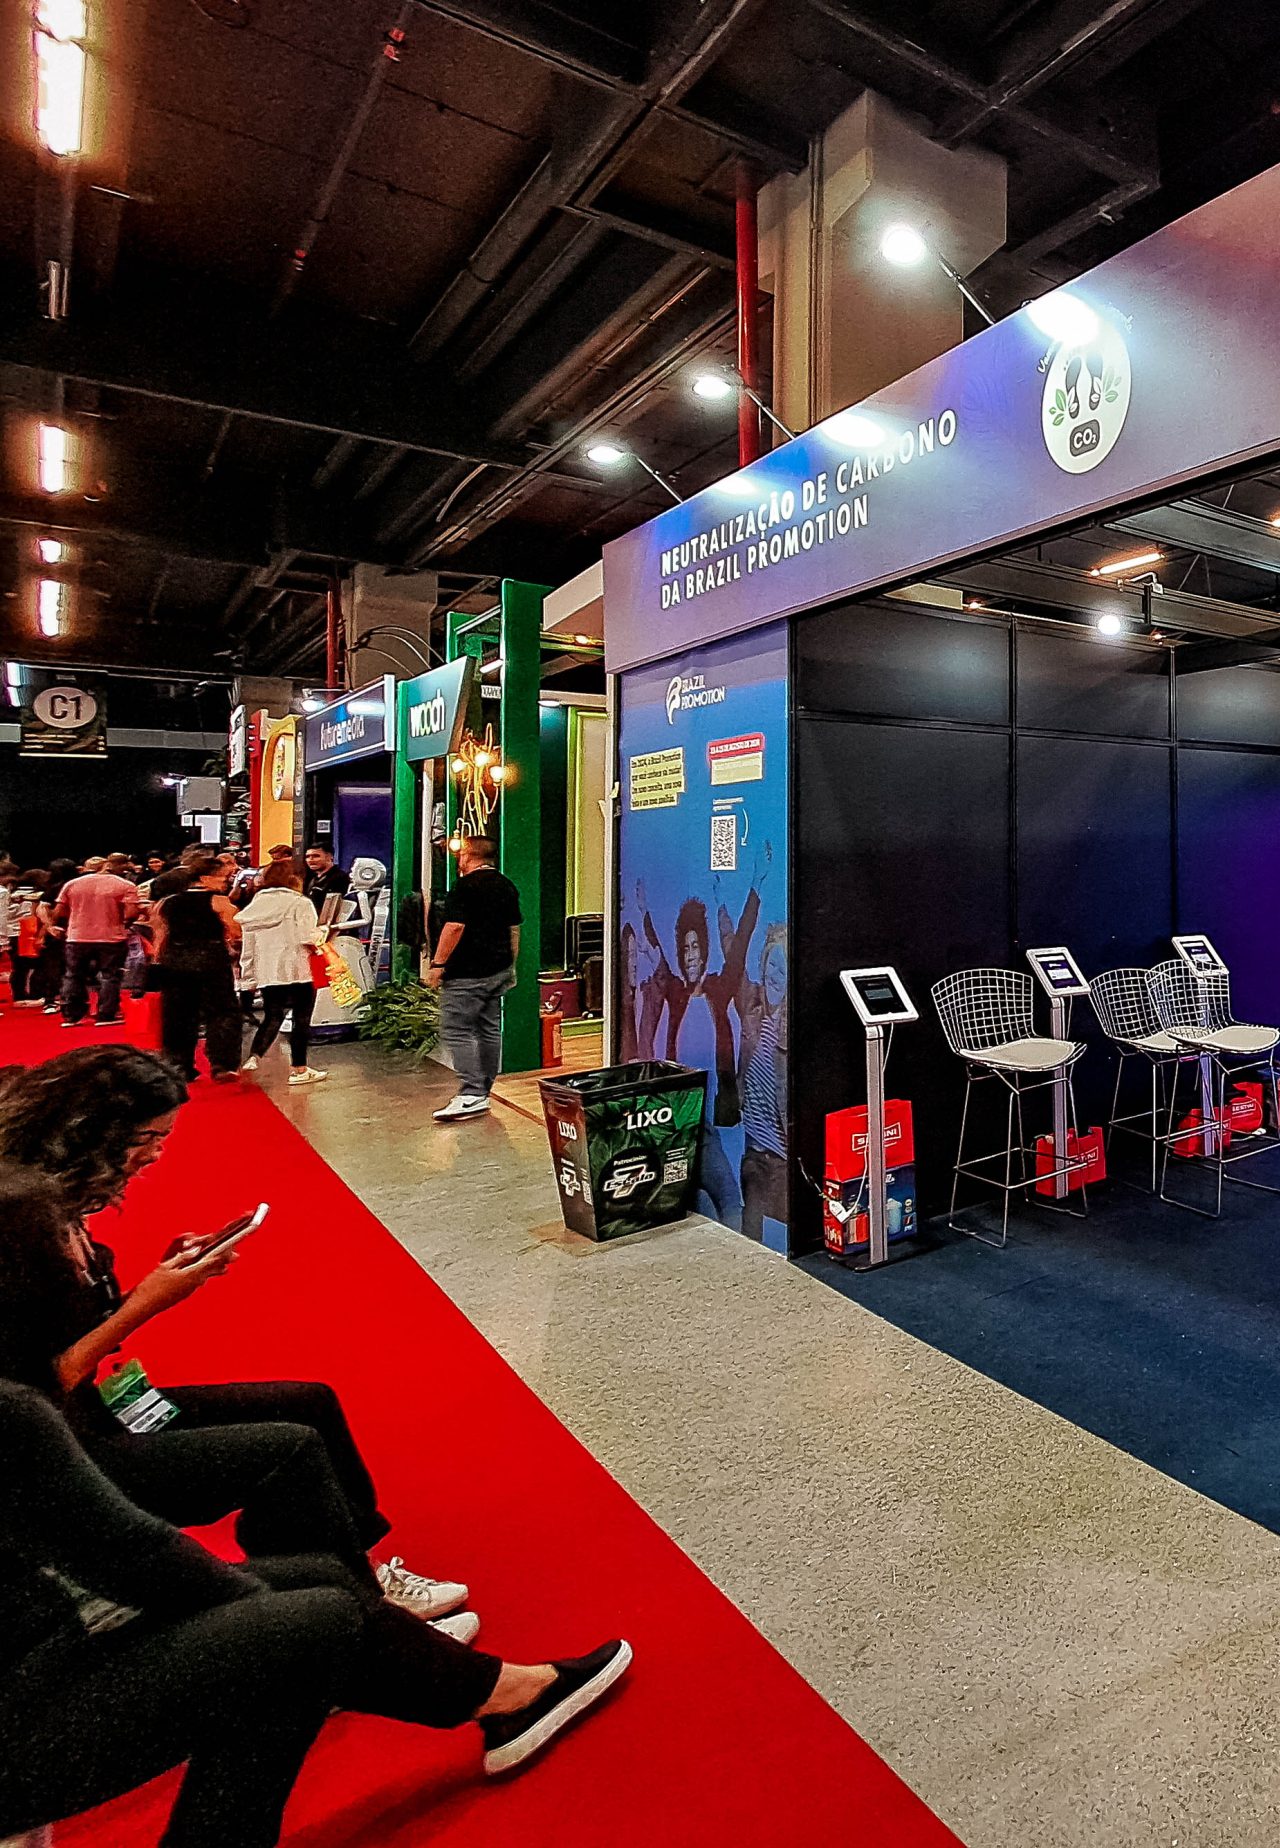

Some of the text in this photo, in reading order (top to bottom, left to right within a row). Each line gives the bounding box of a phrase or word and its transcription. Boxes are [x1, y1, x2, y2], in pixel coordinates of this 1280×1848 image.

[660, 407, 958, 578] NEUTRALIZAÇÃO DE CARBONO
[660, 493, 870, 610] DA BRAZIL PROMOTION
[50, 694, 82, 720] C1
[681, 686, 726, 710] PROMOTION
[558, 1120, 578, 1141] LIXO
[626, 1106, 673, 1131] LIXO
